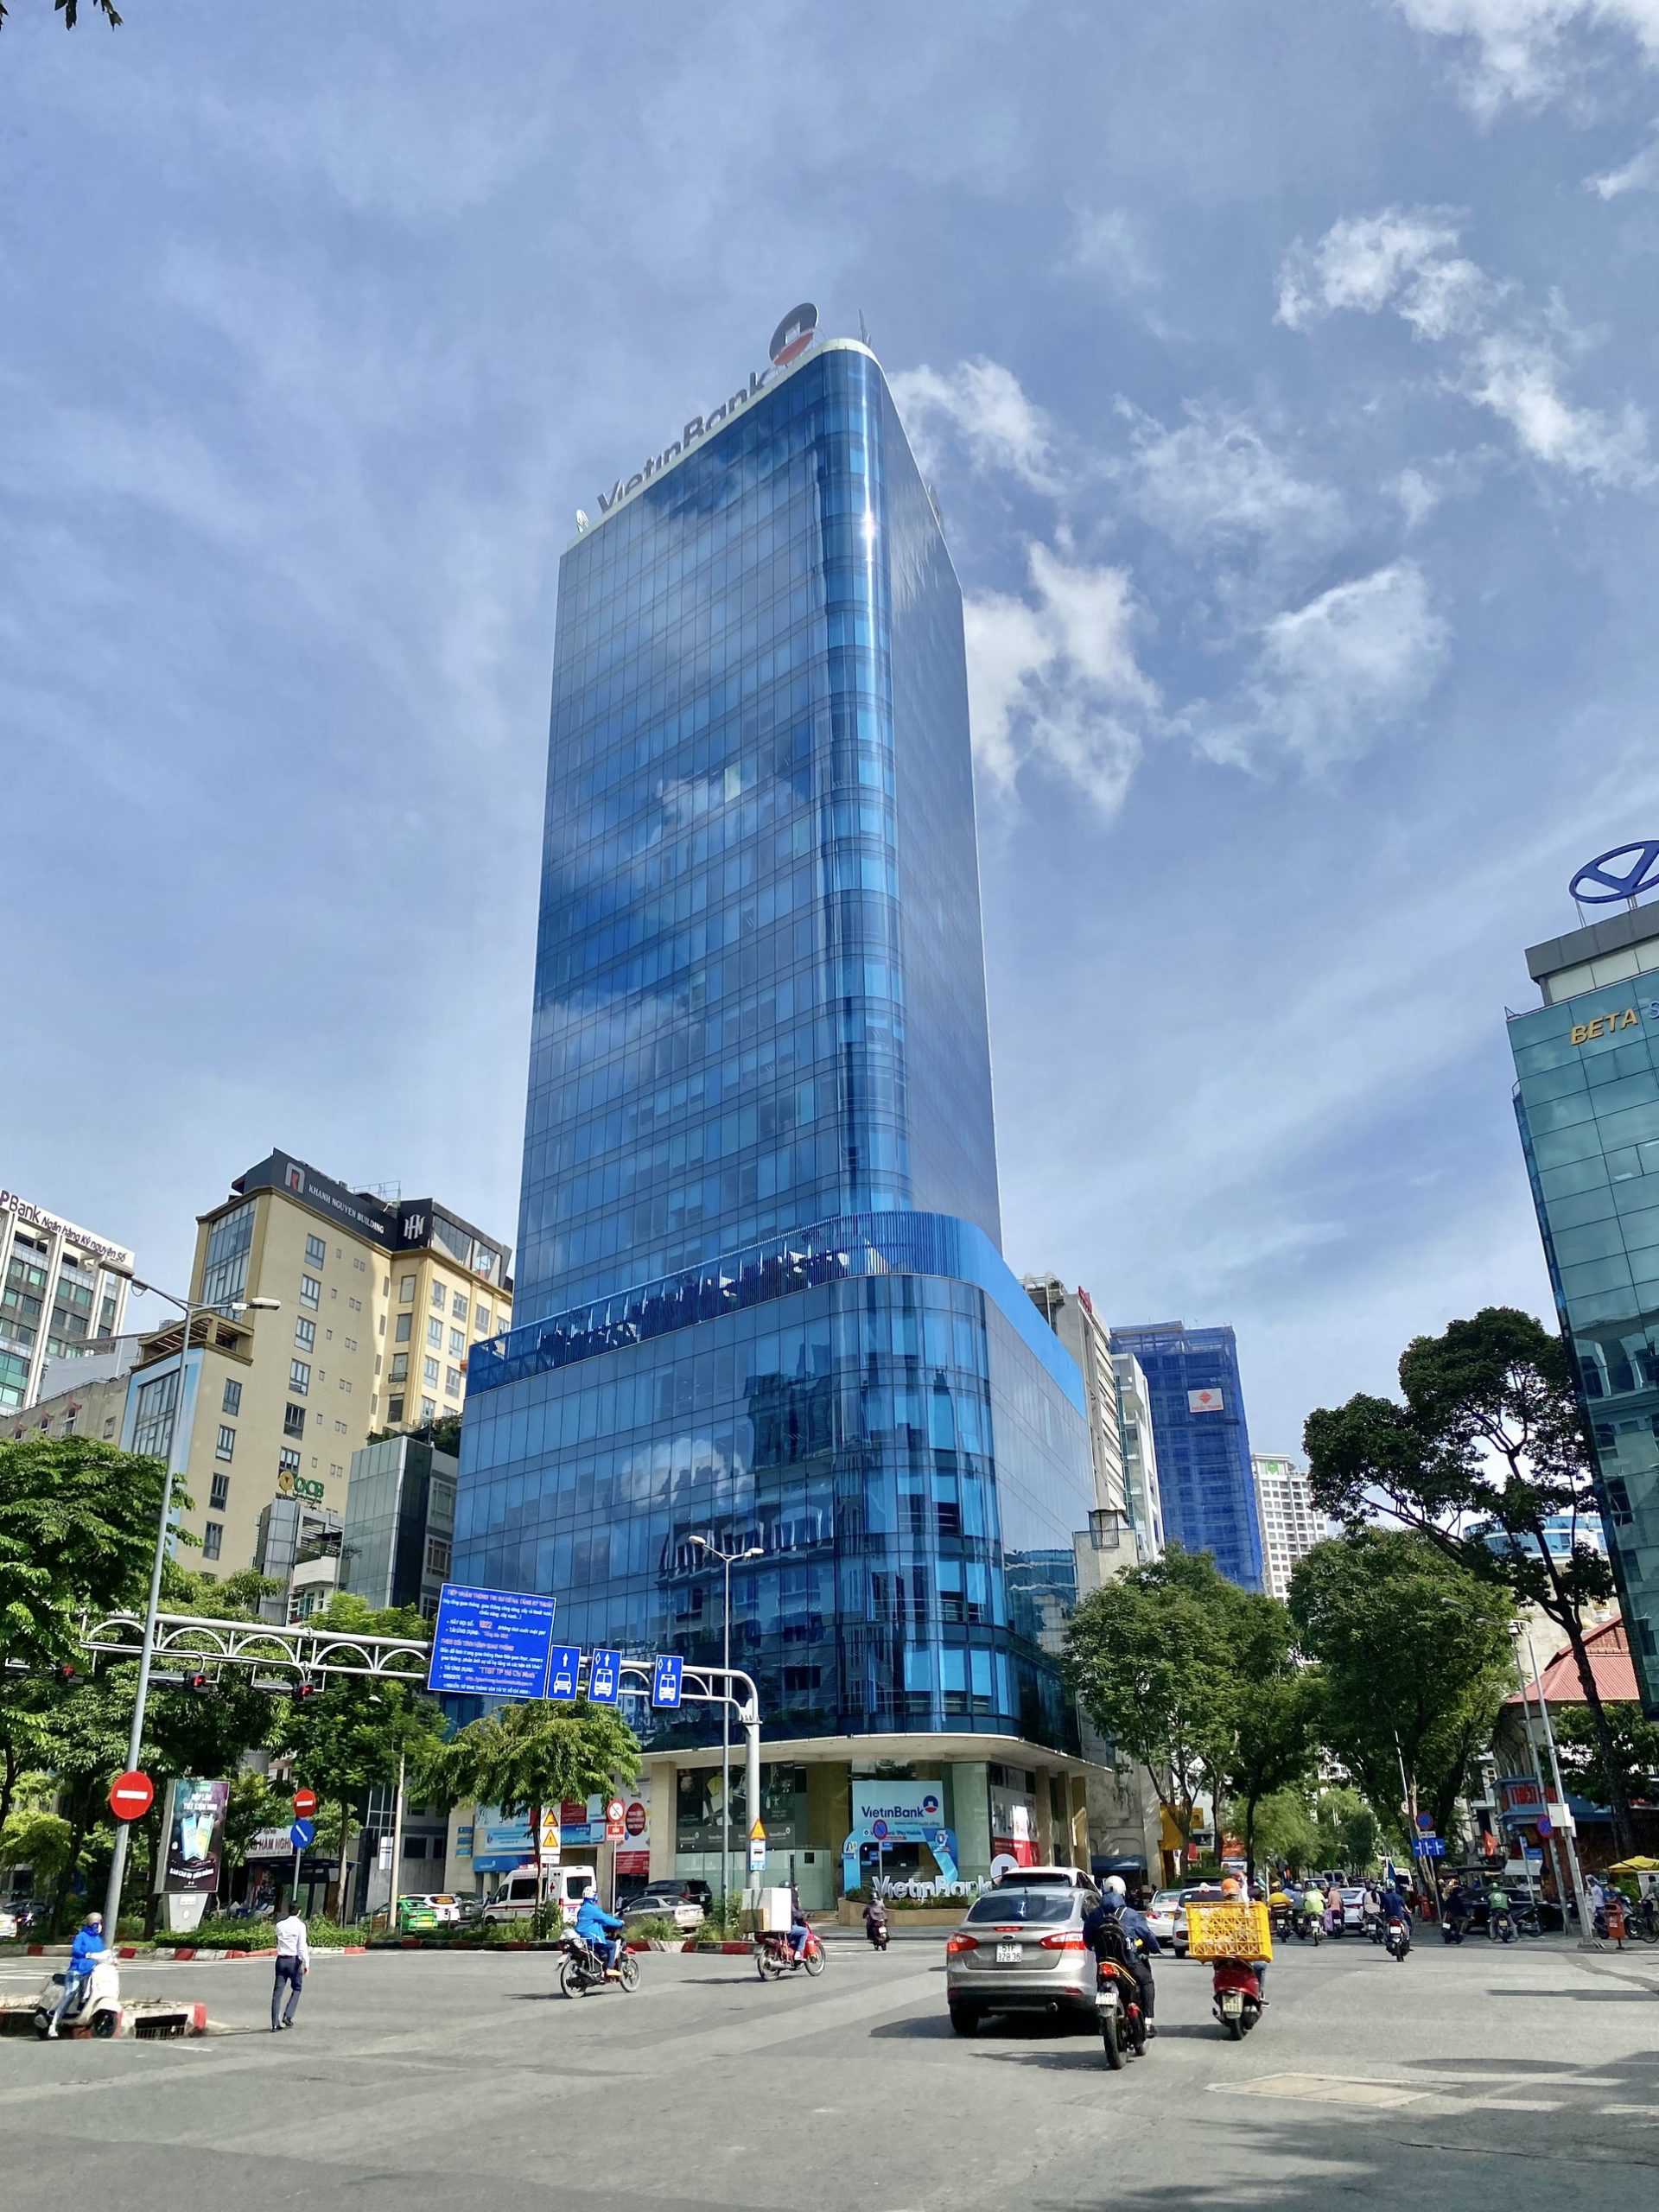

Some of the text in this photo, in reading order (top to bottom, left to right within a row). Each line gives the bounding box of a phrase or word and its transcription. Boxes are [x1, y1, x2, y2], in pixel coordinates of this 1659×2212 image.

[596, 368, 773, 512] VietinBank
[1571, 1008, 1638, 1046] BETA
[308, 1185, 385, 1234] KHANH NGUYEN BUILDING
[294, 1477, 324, 1497] OCB
[861, 1806, 924, 1818] VietinBank
[872, 1875, 992, 1898] VietinBank
[1001, 1944, 1016, 1953] 51F
